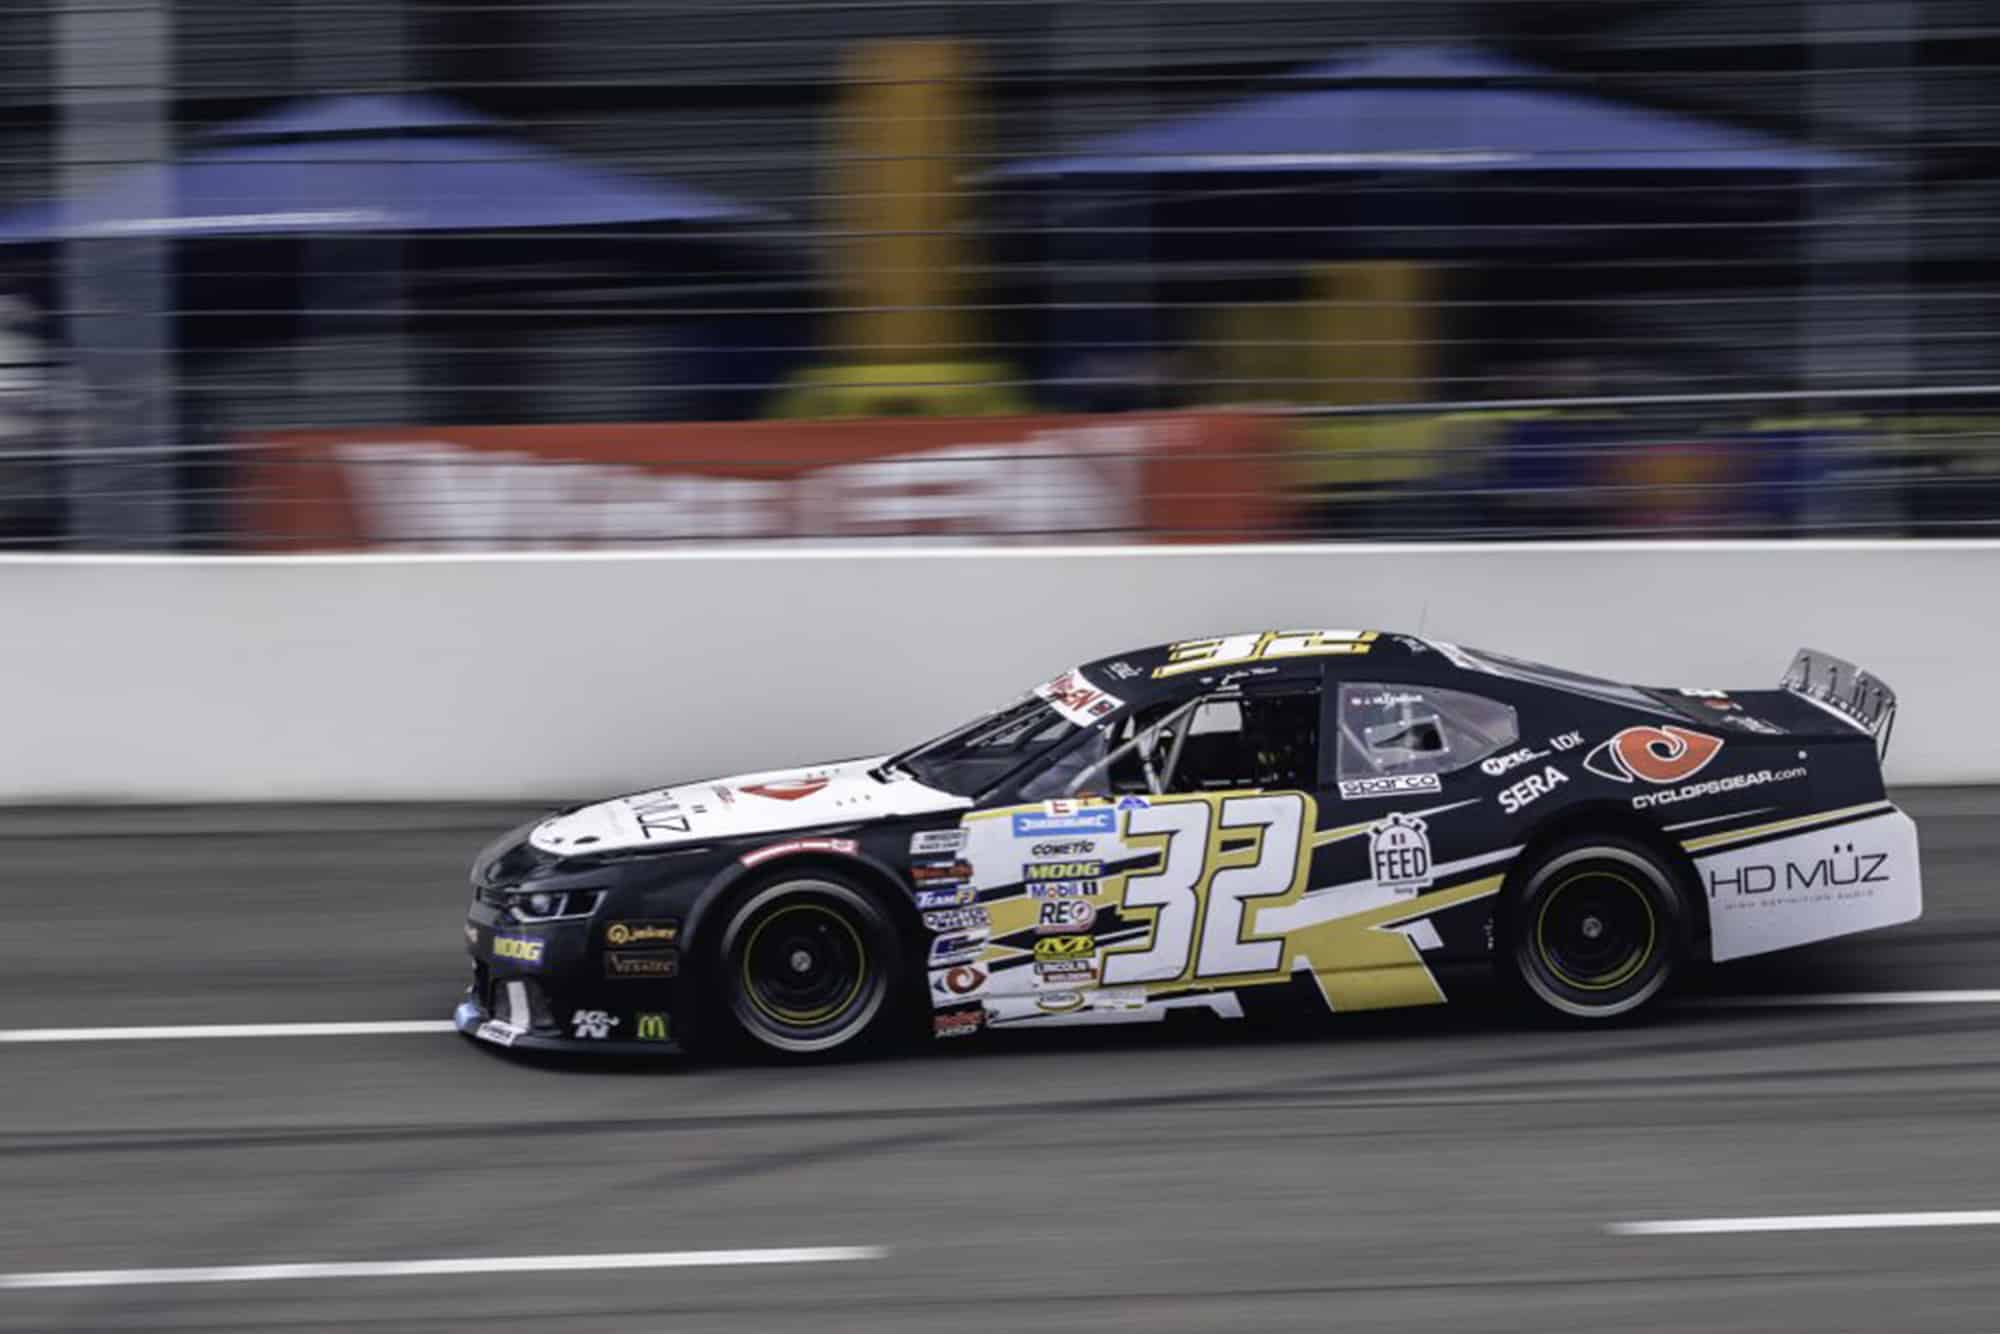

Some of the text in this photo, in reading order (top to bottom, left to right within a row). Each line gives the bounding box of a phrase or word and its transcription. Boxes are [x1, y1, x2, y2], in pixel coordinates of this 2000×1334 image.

[1498, 766, 1569, 813] SERA
[1632, 766, 1807, 810] CYCLOPSGEAR.com
[1026, 861, 1101, 880] MOOG
[1375, 847, 1429, 882] FEED
[1710, 843, 1890, 899] HD MÜZ
[1031, 882, 1079, 898] Mobil
[1099, 793, 1306, 986] 32
